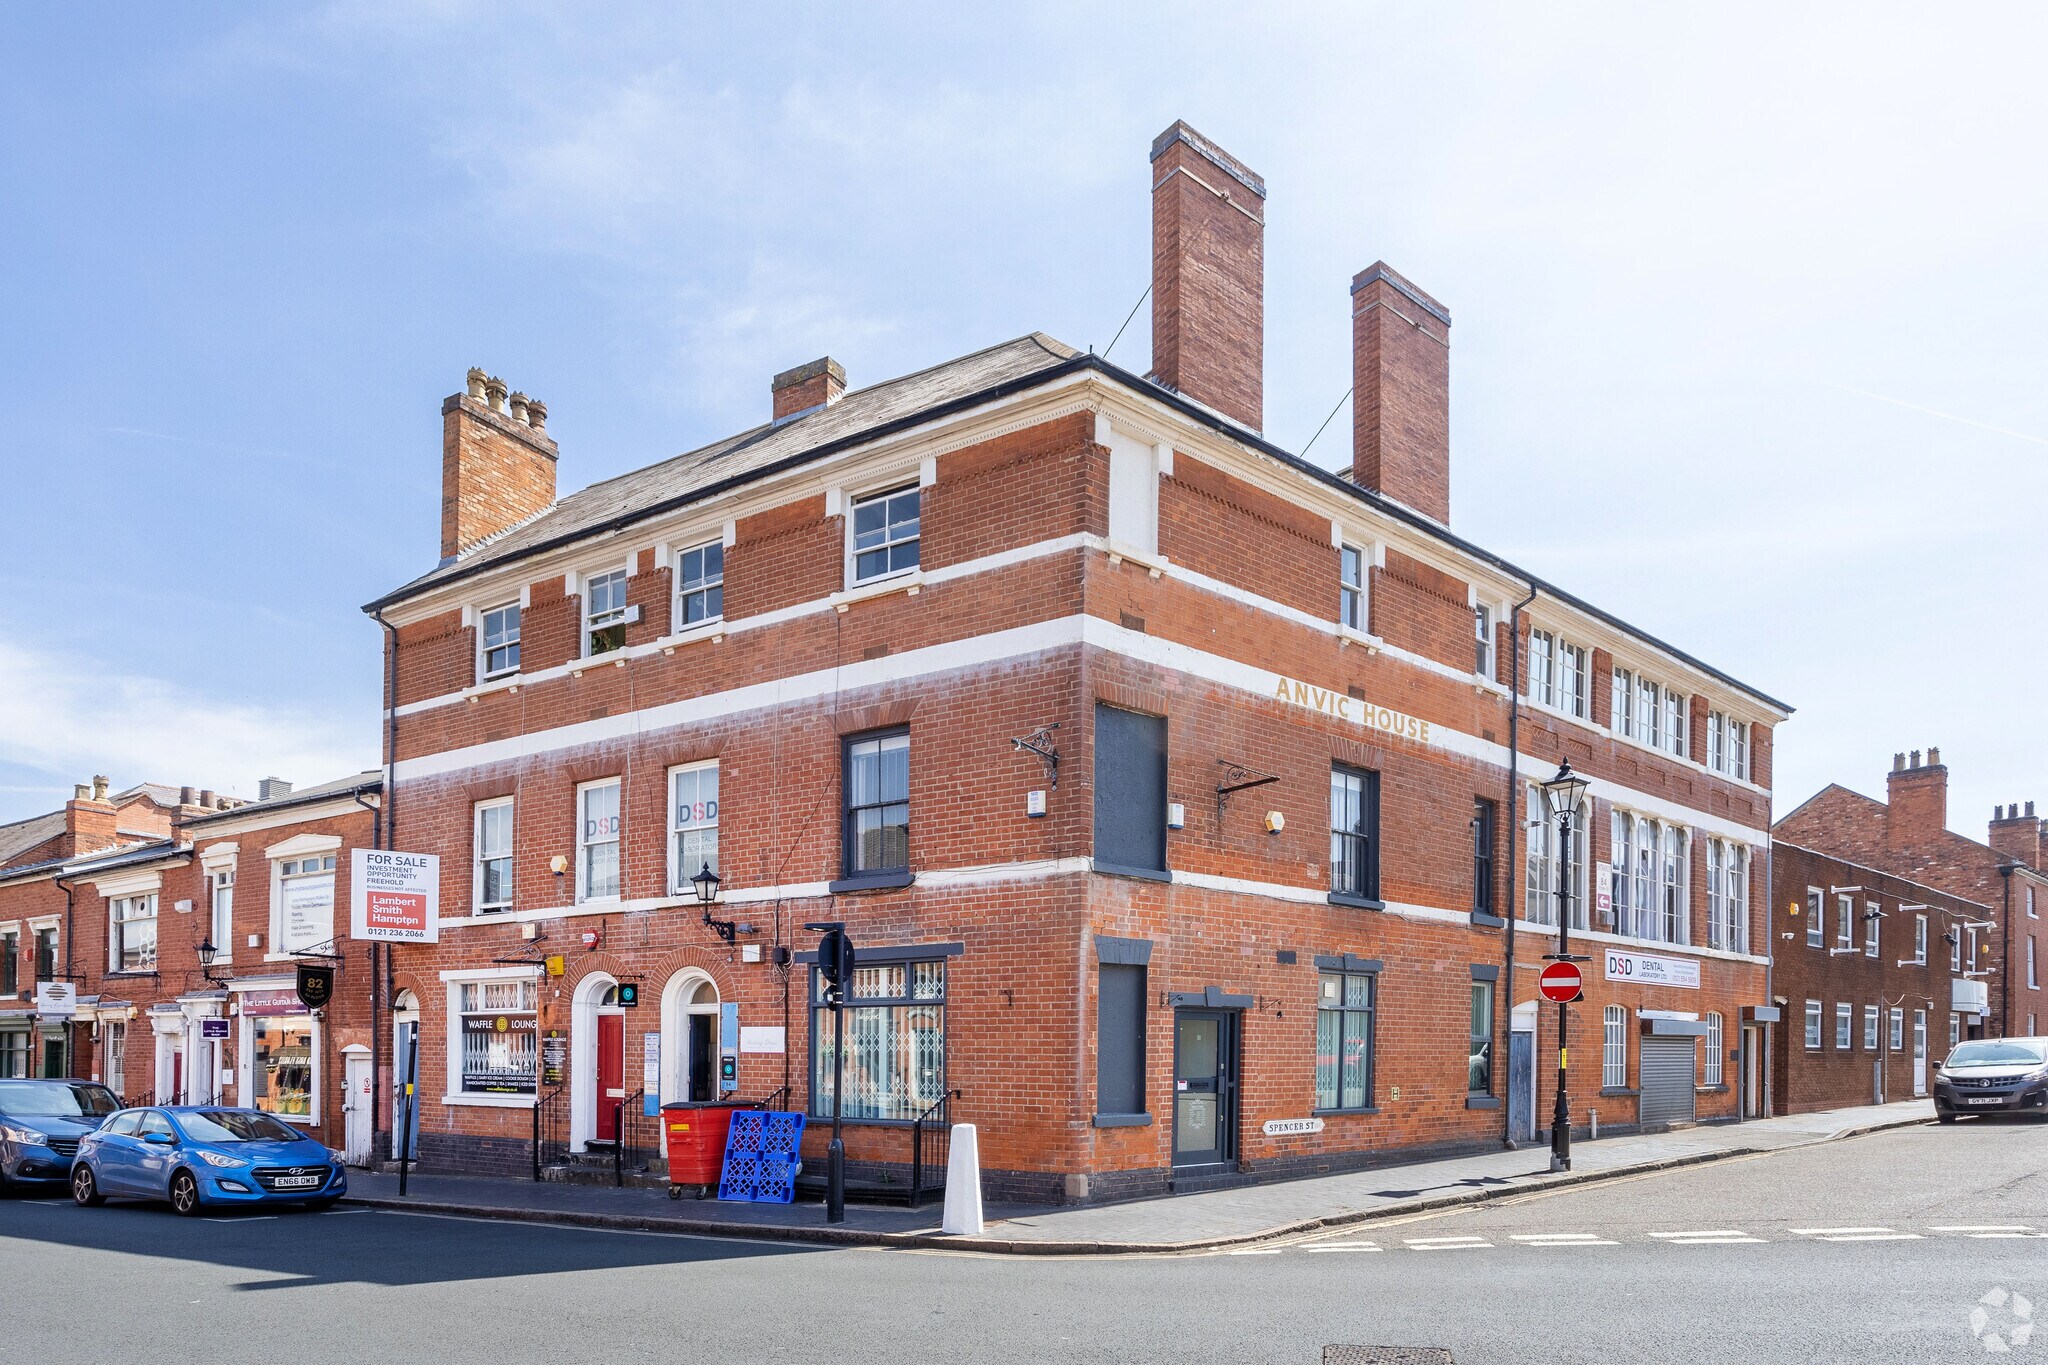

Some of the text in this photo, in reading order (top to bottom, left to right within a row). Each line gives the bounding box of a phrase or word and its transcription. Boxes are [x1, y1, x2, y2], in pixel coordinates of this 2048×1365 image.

[1276, 677, 1429, 742] ANVIC HOUSE
[679, 800, 718, 823] DSD
[587, 816, 620, 837] DSD
[367, 853, 427, 868] FOR SALE
[367, 865, 413, 874] INVESTMENT
[367, 871, 417, 880] OPPORTUNITY
[366, 878, 404, 886] FREEHOLD
[372, 895, 416, 906] Lambert
[372, 905, 403, 915] Smith
[389, 929, 403, 937] 236
[405, 930, 424, 938] 2066
[1609, 956, 1633, 976] DSD
[1642, 960, 1664, 972] DENTAL
[1639, 971, 1661, 979] LABORATORY
[307, 978, 323, 989] 82
[272, 998, 291, 1006] GUITAR
[468, 1020, 537, 1029] WAFFLE LOUNG
[1269, 1121, 1315, 1132] SPENCER ST
[278, 1177, 299, 1186] EN66
